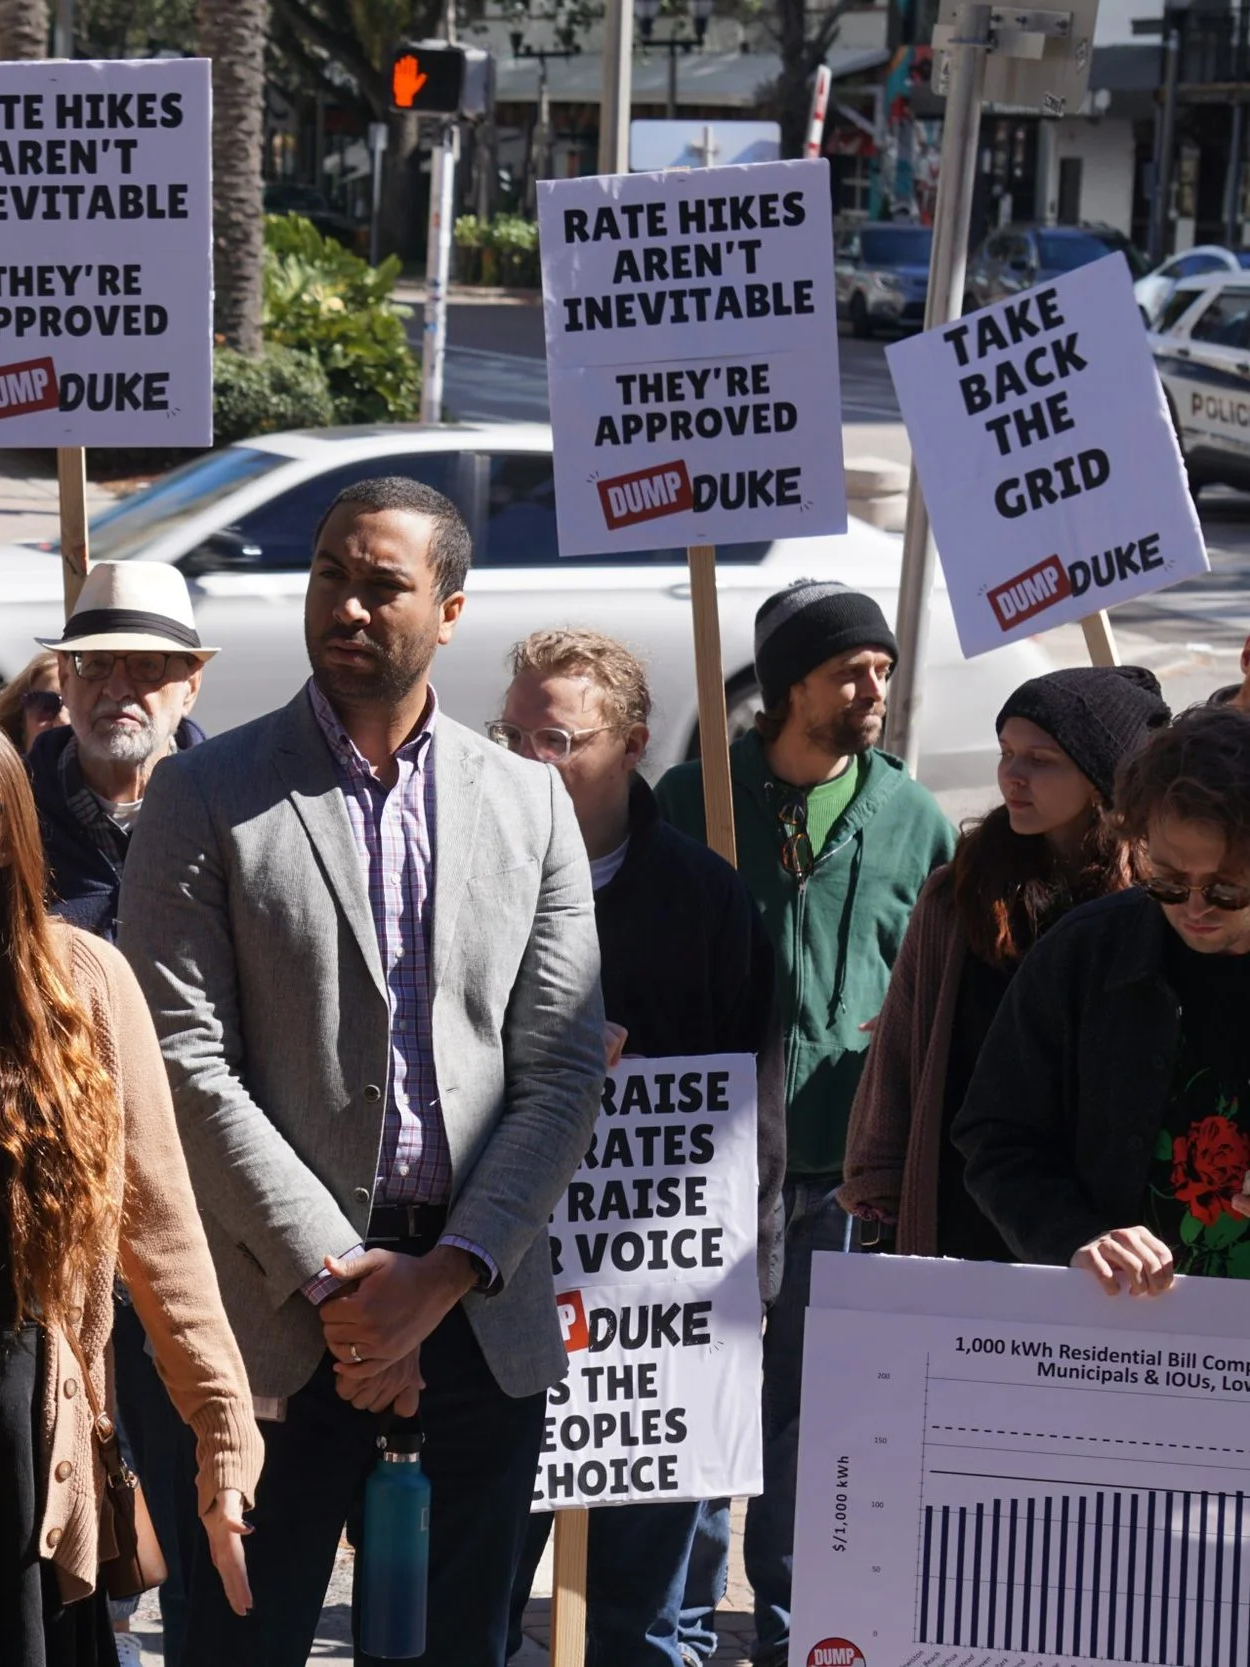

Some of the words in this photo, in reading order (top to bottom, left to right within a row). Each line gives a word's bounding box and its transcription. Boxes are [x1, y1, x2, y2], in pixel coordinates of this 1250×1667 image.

[55, 92, 184, 130] HIKES
[563, 203, 668, 244] RATE
[678, 191, 806, 235] HIKES
[612, 238, 762, 285] AREN'T
[563, 279, 815, 333] INEVITABLE
[943, 287, 1065, 367] TAKE
[59, 372, 170, 412] DUKE
[615, 363, 771, 406] THEY'RE
[959, 332, 1088, 416] BACK
[594, 401, 798, 447] APPROVED
[985, 391, 1075, 456] THE
[607, 470, 683, 519] DUMP
[692, 466, 802, 513] DUKE
[994, 448, 1110, 519] GRID
[996, 565, 1060, 621] DUMP
[1067, 532, 1164, 598] DUKE
[567, 1175, 707, 1223] RAISE
[574, 1228, 724, 1274] VOICE
[587, 1301, 713, 1353] DUKE
[955, 1336, 1006, 1356] 1,000
[1011, 1339, 1053, 1358] kWh
[1058, 1343, 1162, 1367] Residential
[1167, 1352, 1197, 1369] Bill
[581, 1362, 658, 1403] THE
[877, 1372, 891, 1380] 200
[1037, 1361, 1139, 1385] Municipals
[1144, 1369, 1160, 1386] &
[1165, 1371, 1216, 1393] IOUs,
[874, 1436, 888, 1445] 150
[836, 1455, 849, 1488] kWh
[832, 1493, 848, 1552] $/1,000
[871, 1500, 885, 1509] 100
[871, 1564, 881, 1573] 50
[814, 1647, 855, 1666] DUMP
